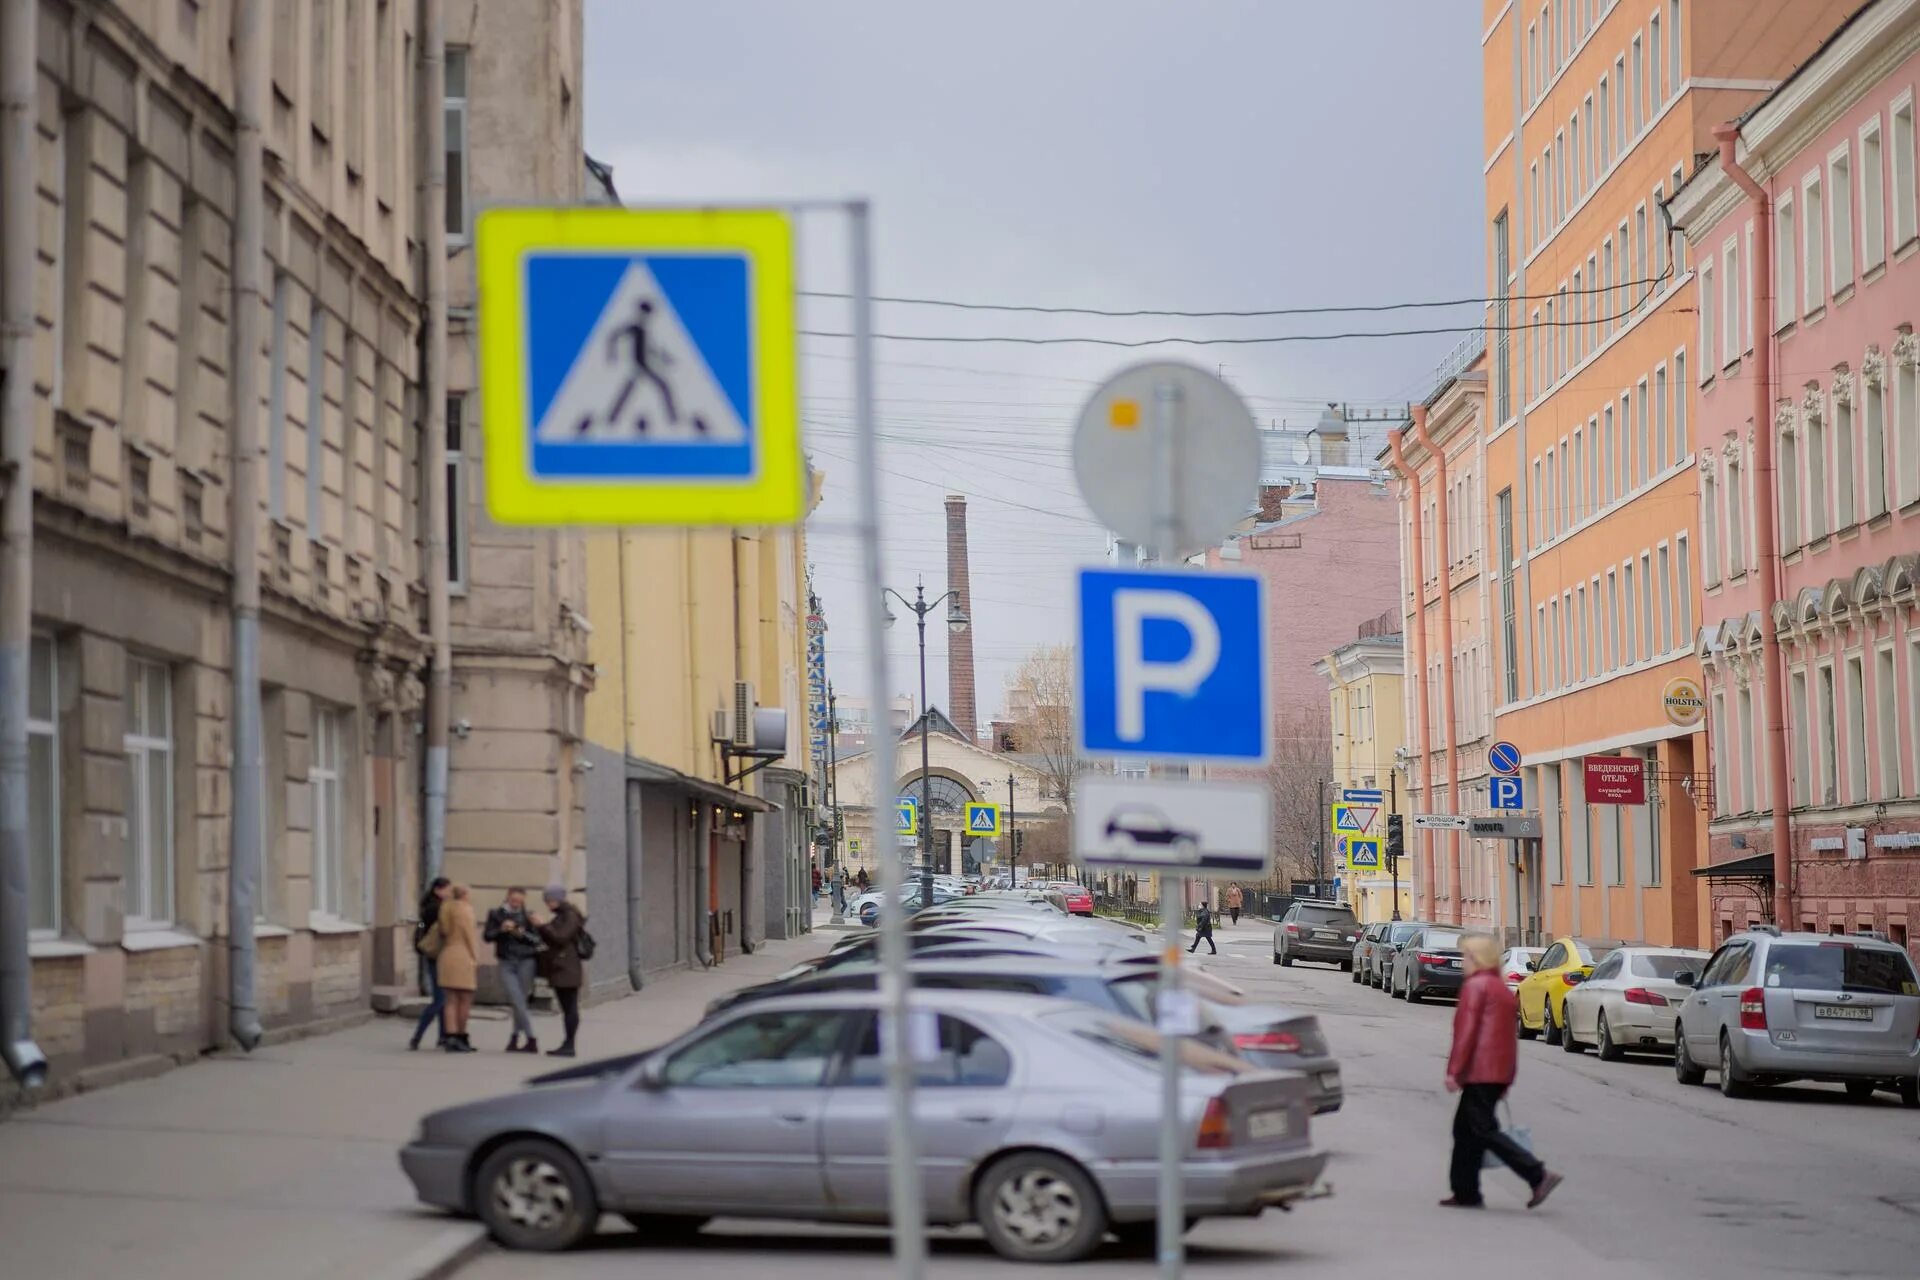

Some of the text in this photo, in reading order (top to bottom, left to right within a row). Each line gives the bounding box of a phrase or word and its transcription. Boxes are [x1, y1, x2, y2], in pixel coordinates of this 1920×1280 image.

[1111, 588, 1221, 743] P
[1665, 697, 1704, 707] HOLSTEN
[1588, 764, 1640, 774] ВВЕДЕНСКИЙ
[1601, 774, 1628, 783] ОТЕЛЬ
[1498, 781, 1518, 808] P
